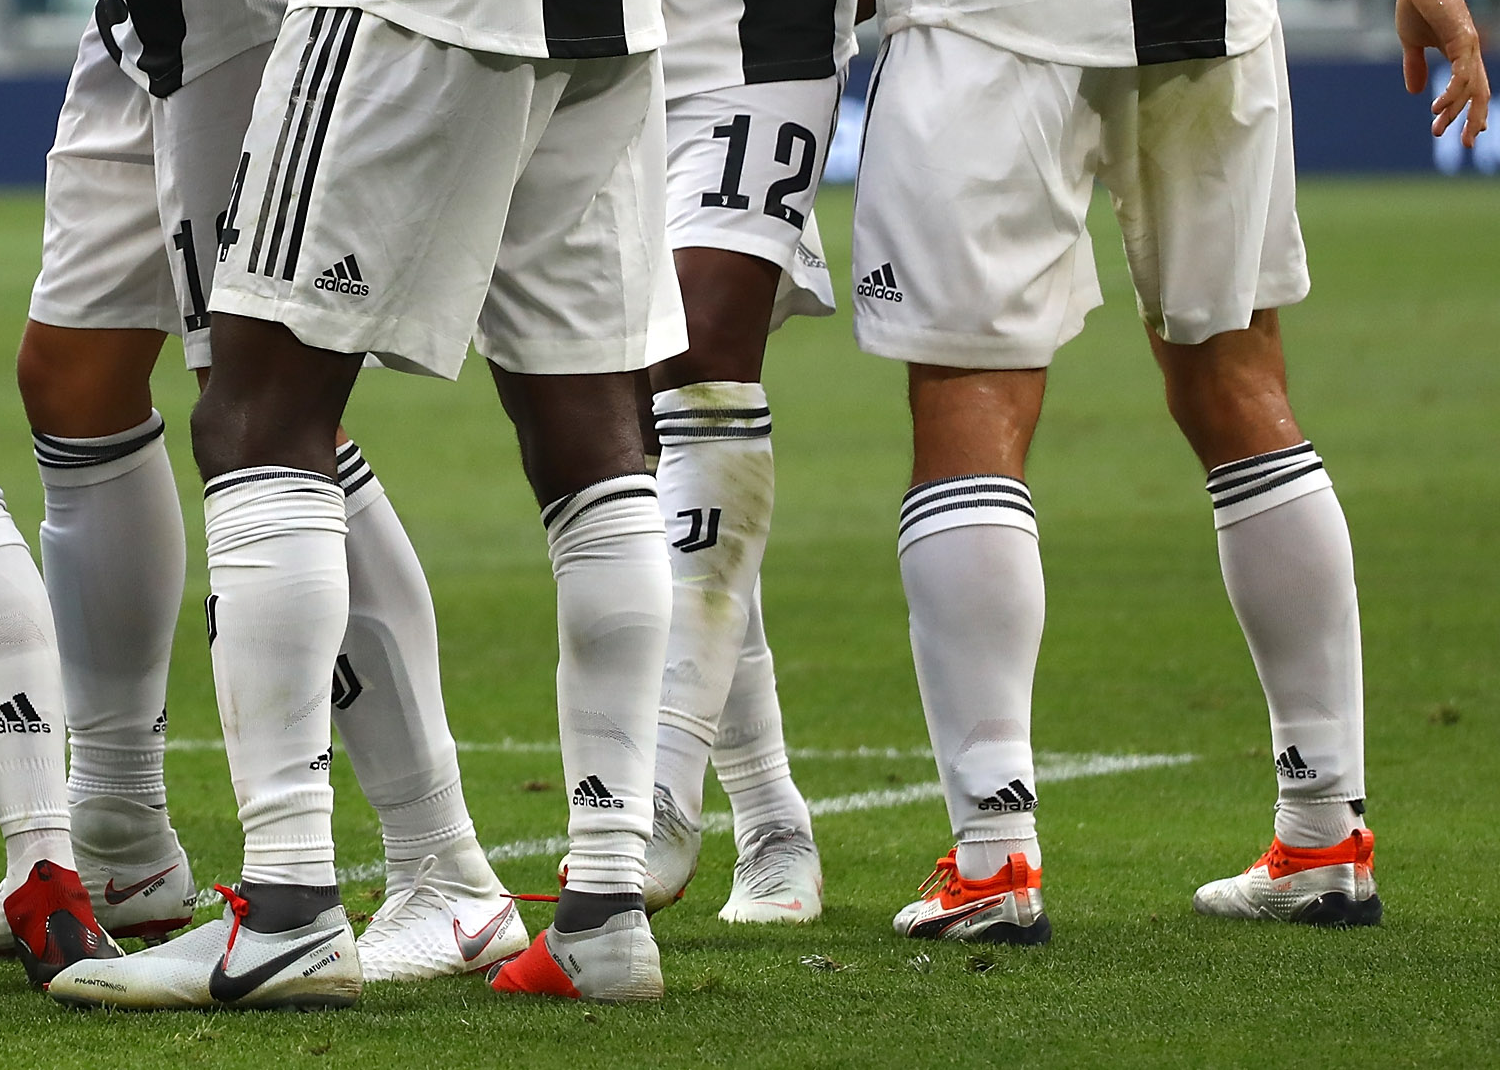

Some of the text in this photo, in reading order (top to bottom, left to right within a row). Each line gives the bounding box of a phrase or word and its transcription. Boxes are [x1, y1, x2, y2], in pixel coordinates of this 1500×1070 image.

[701, 115, 817, 231] 12
[314, 276, 369, 296] adidas
[857, 283, 903, 303] adidas
[572, 794, 624, 809] adidas
[302, 957, 331, 978] MATUIDI
